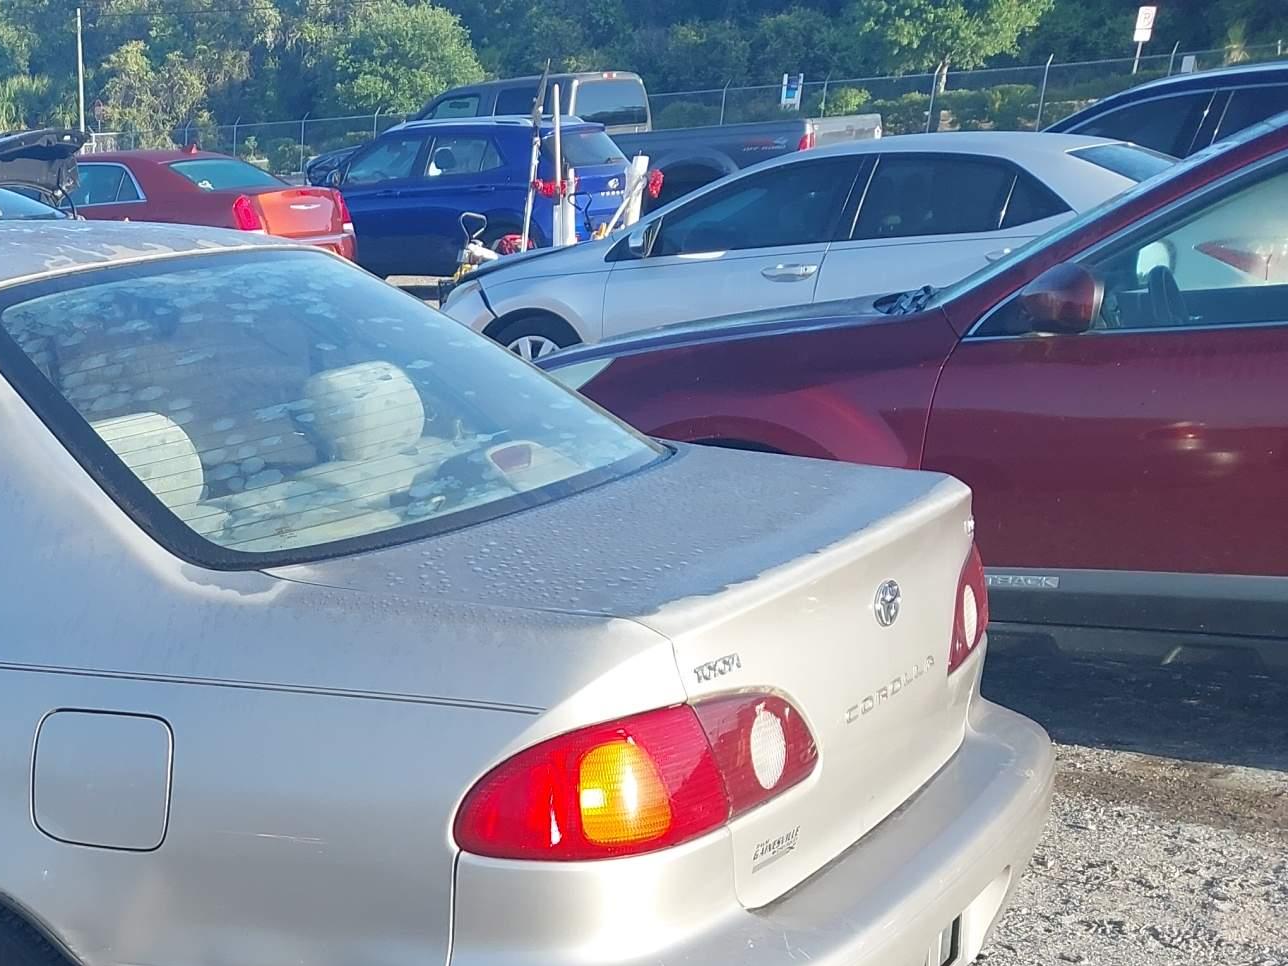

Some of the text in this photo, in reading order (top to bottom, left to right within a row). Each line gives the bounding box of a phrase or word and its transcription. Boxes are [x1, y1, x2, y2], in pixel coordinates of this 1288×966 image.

[984, 575, 1060, 589] TBACK
[693, 652, 742, 684] TOYOTA
[844, 655, 935, 725] COROLLA
